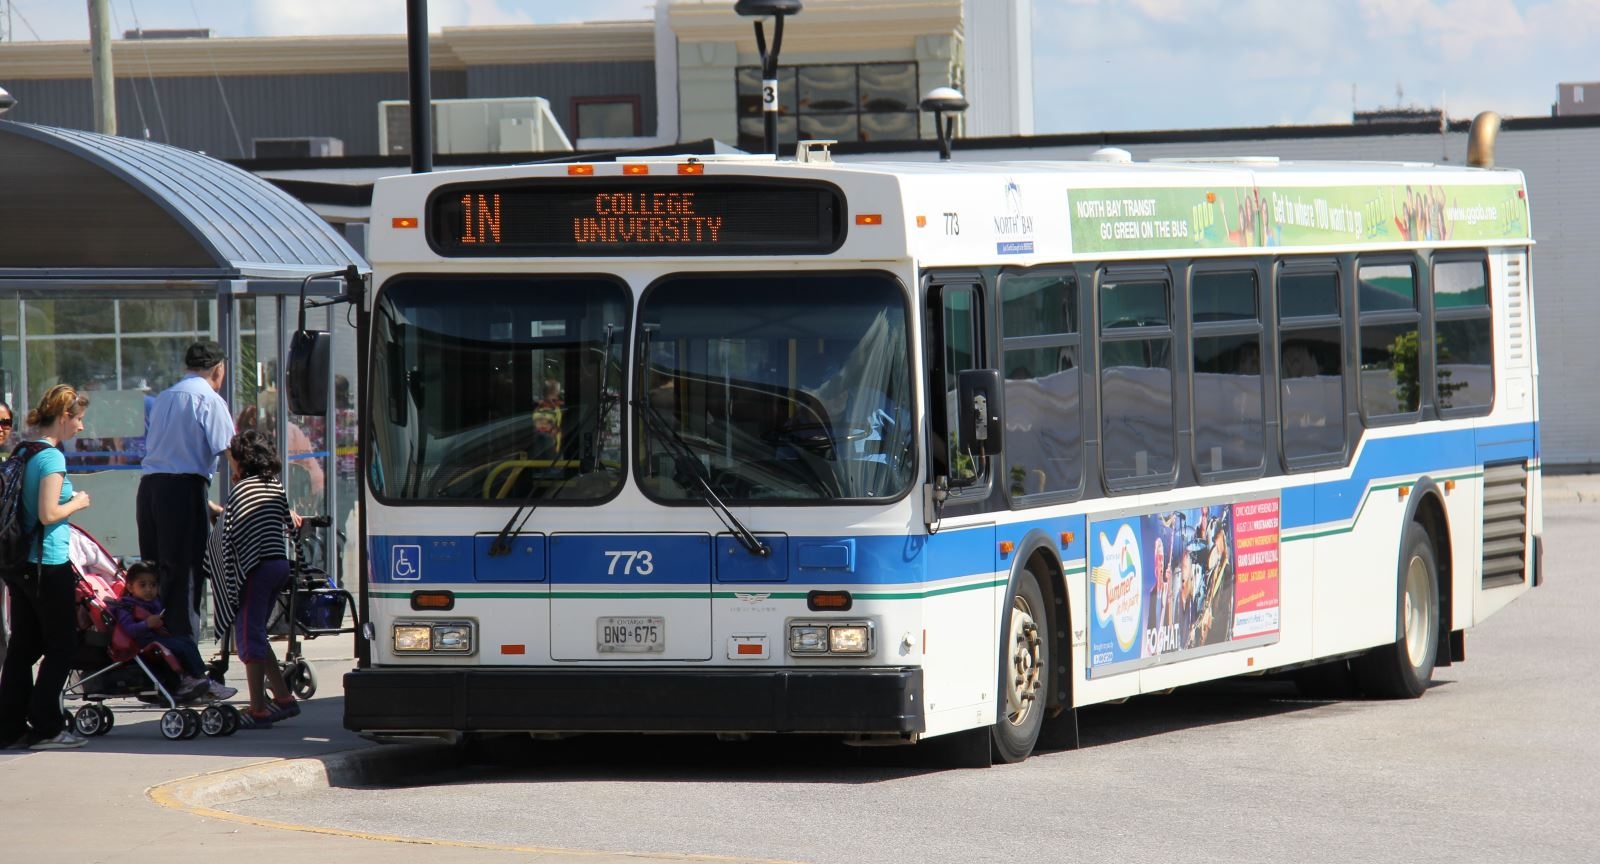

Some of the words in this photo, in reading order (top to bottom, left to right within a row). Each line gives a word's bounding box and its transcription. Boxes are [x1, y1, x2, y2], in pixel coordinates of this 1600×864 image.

[763, 86, 775, 104] 3
[596, 193, 695, 215] COLLEGE
[1076, 200, 1105, 218] NORTH
[1106, 199, 1122, 217] BAY
[1123, 199, 1156, 217] TRANSIT
[1272, 191, 1286, 224] Get
[1285, 194, 1294, 225] to
[1294, 196, 1315, 228] where
[1314, 198, 1329, 230] YOU
[1329, 204, 1346, 232] want
[1346, 204, 1354, 233] to
[1354, 210, 1363, 240] go
[461, 194, 501, 243] 1N
[574, 217, 722, 243] UNIVERSITY
[943, 212, 960, 236] 773
[993, 215, 1018, 235] NORTH
[1021, 215, 1034, 235] BAY
[1100, 222, 1112, 240] GO
[1114, 221, 1140, 239] GREEN
[1141, 221, 1153, 239] ON
[1154, 220, 1170, 238] THE
[1171, 220, 1188, 238] BUS
[605, 550, 654, 576] 773
[1104, 576, 1134, 614] Summer
